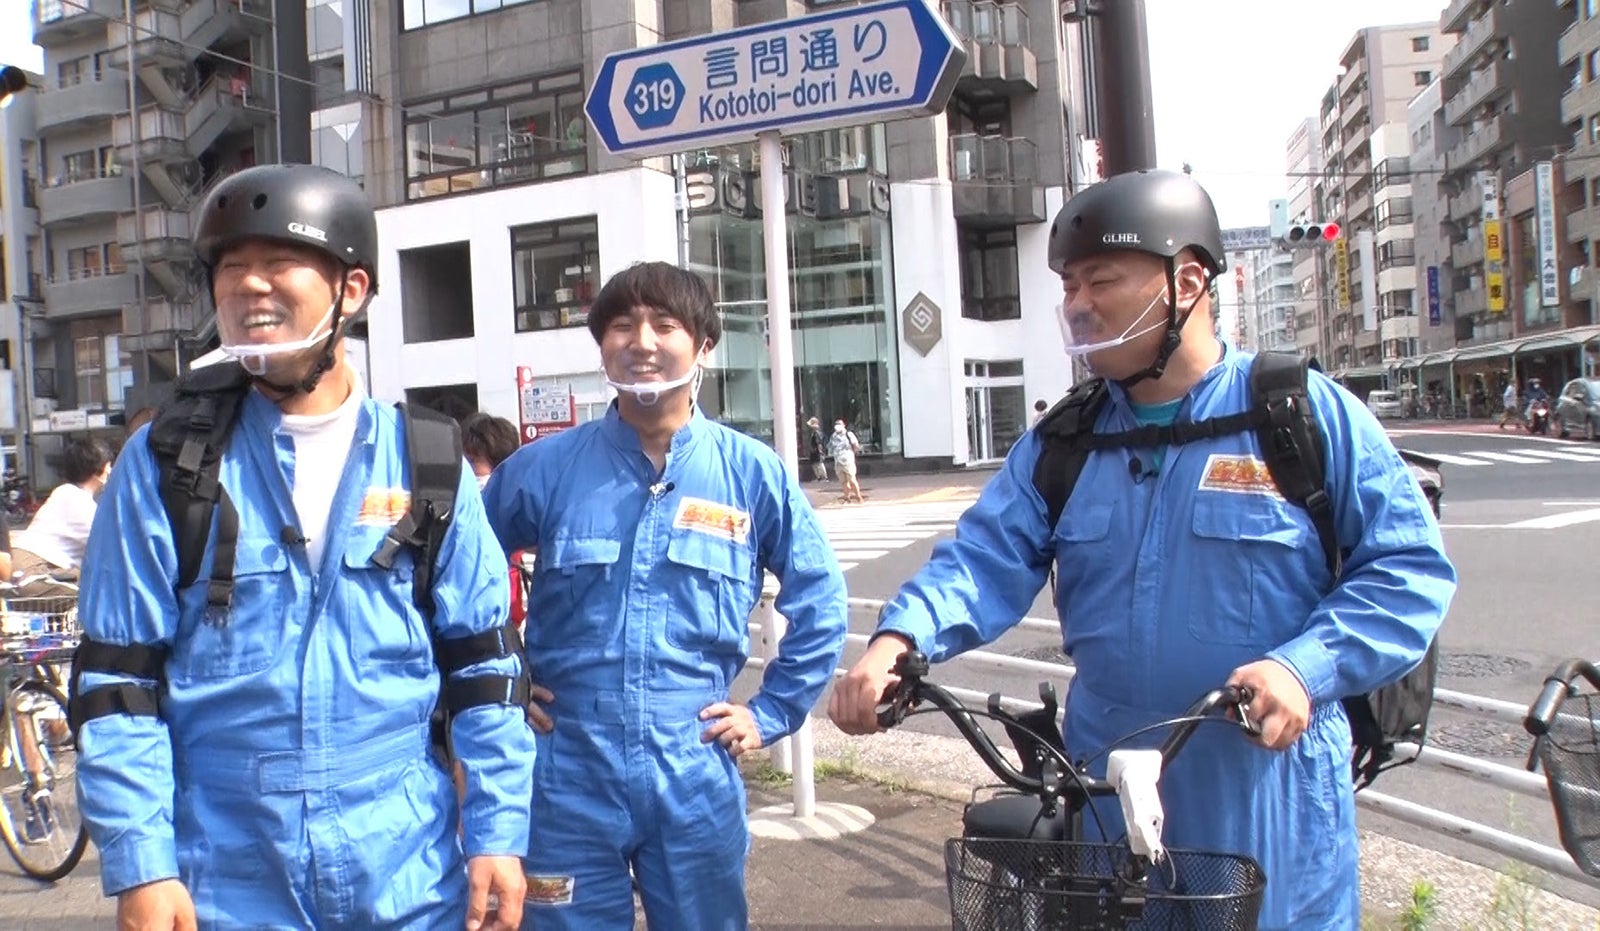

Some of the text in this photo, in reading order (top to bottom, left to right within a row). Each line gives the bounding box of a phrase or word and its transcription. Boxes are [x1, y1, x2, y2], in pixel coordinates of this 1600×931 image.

[703, 19, 888, 90] 言問通り
[633, 78, 676, 115] 319
[700, 69, 900, 123] Kototoi-dori Ave.
[1102, 232, 1141, 243] GLHEL
